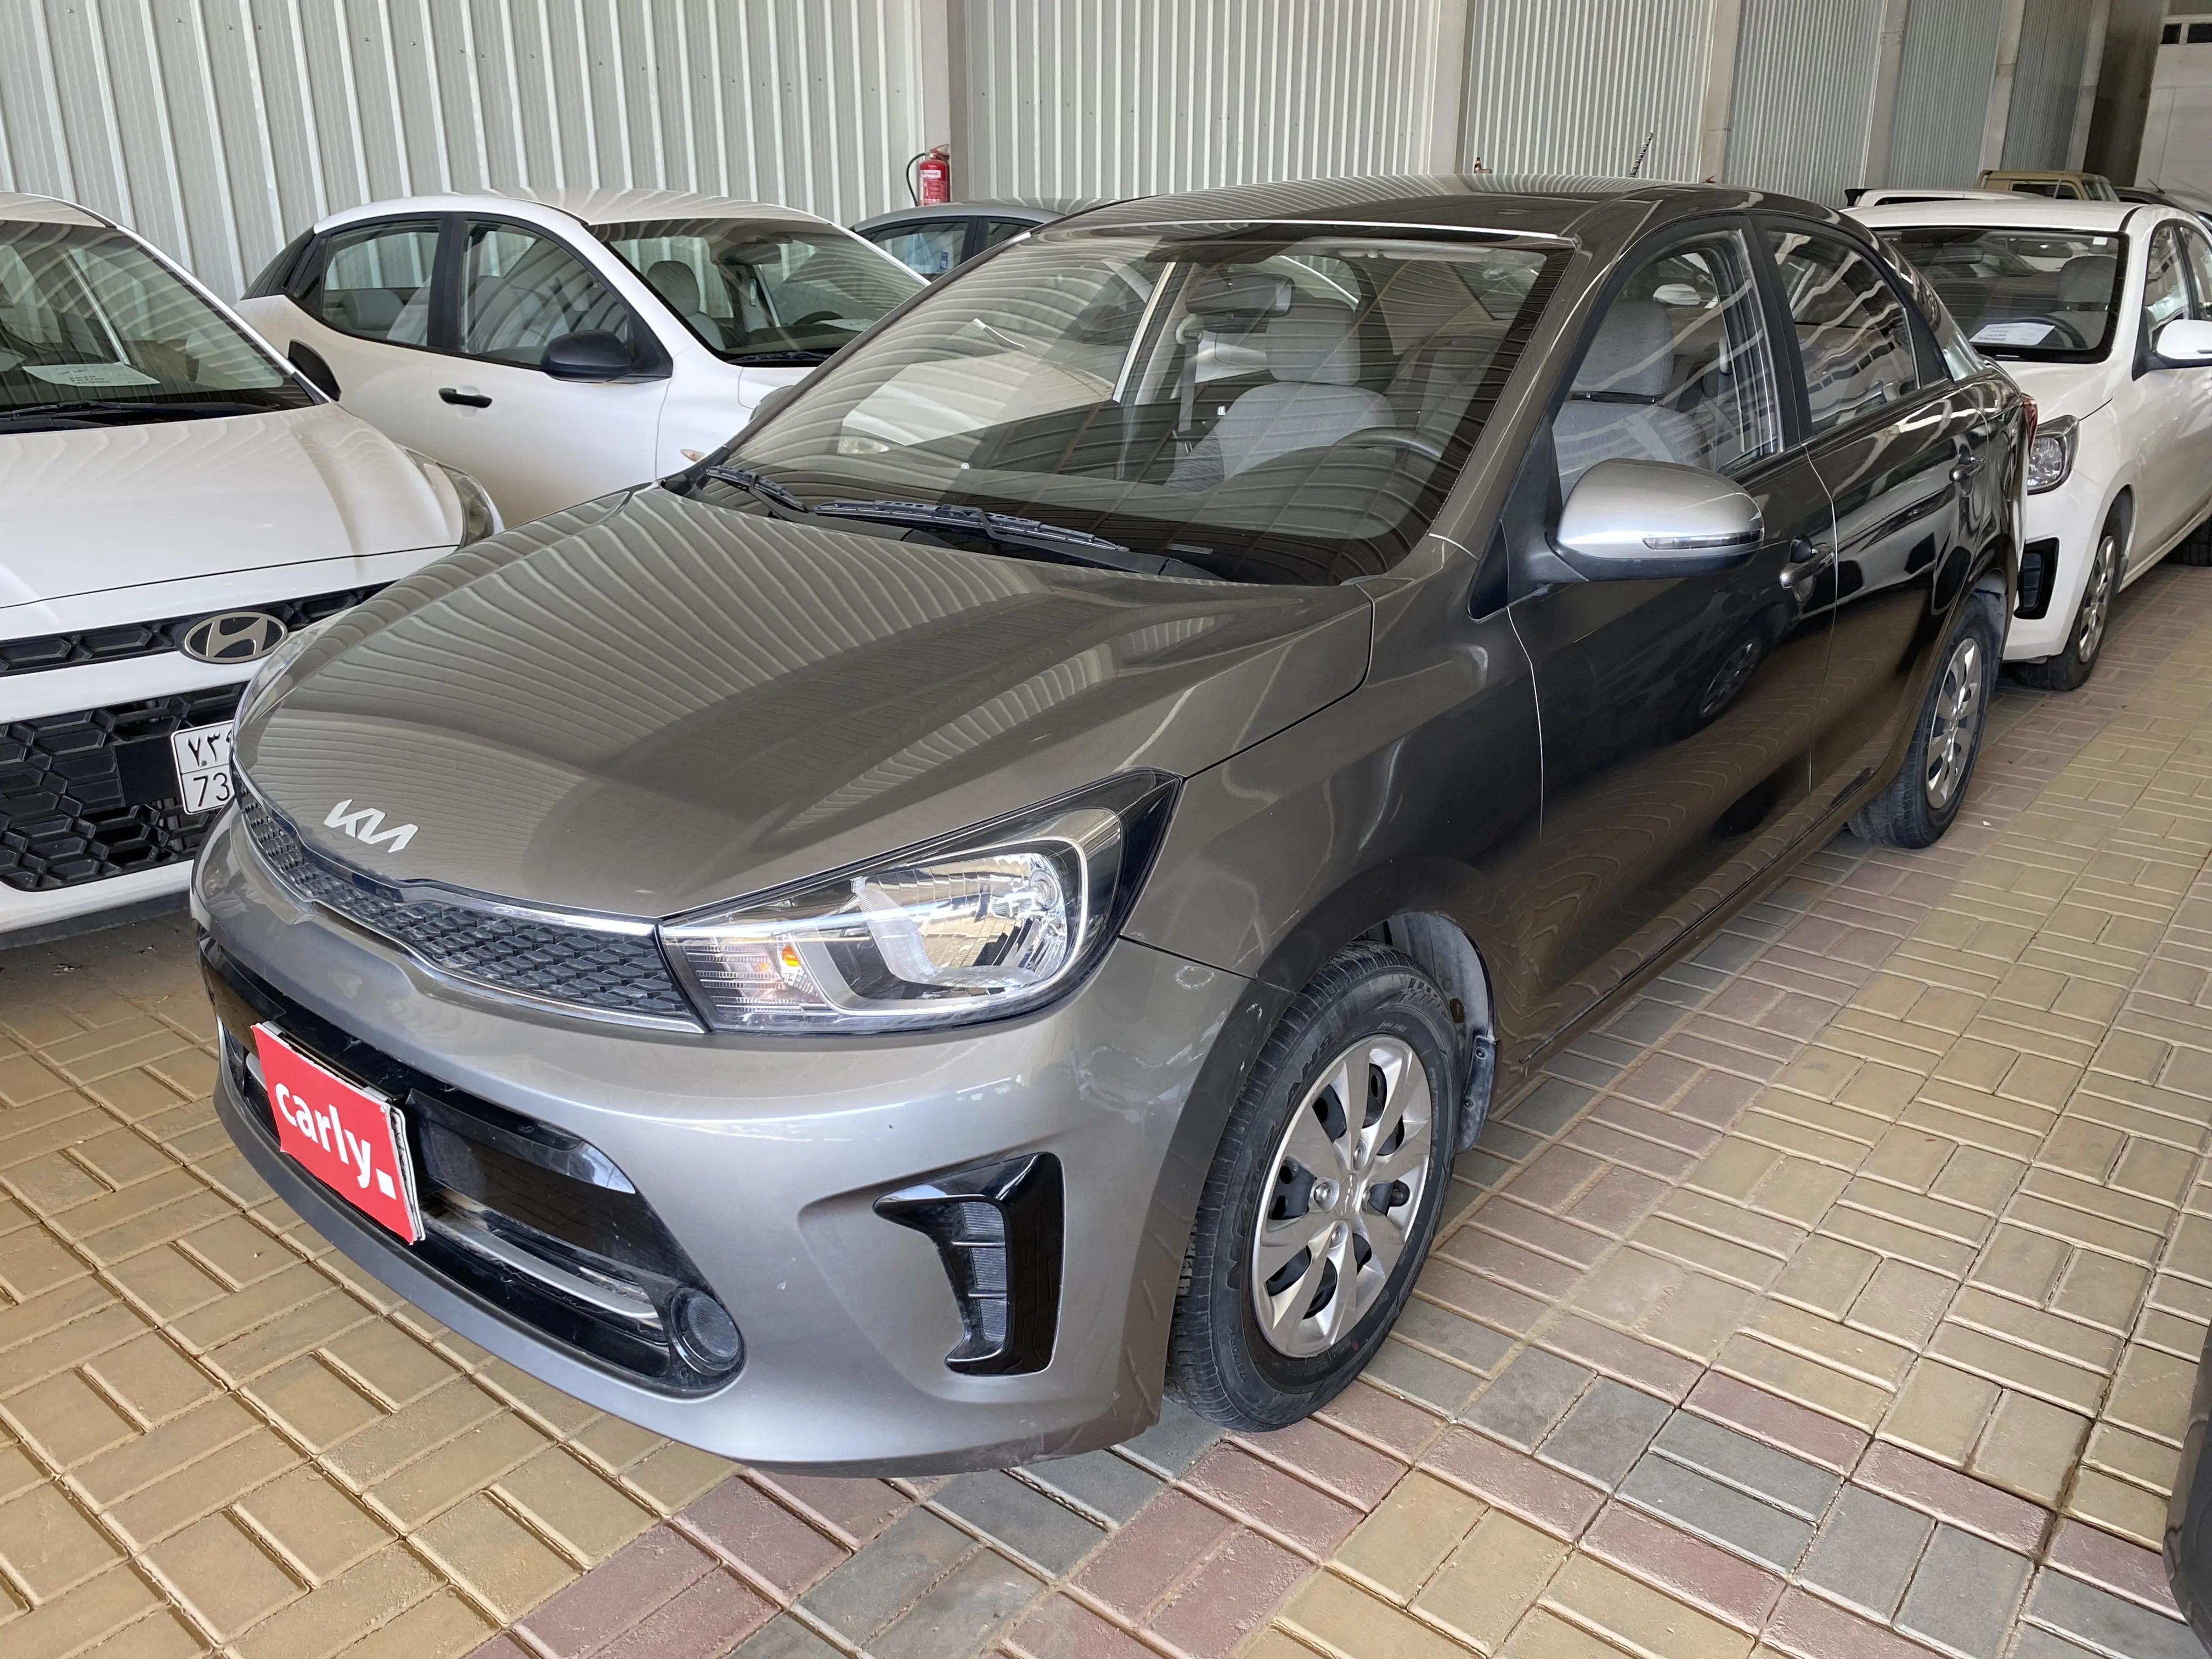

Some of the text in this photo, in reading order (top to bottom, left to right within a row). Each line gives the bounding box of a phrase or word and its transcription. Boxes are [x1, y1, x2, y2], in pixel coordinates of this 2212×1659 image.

[193, 772, 230, 807] 73
[324, 799, 419, 853] KIA
[275, 1083, 397, 1200] carly.
